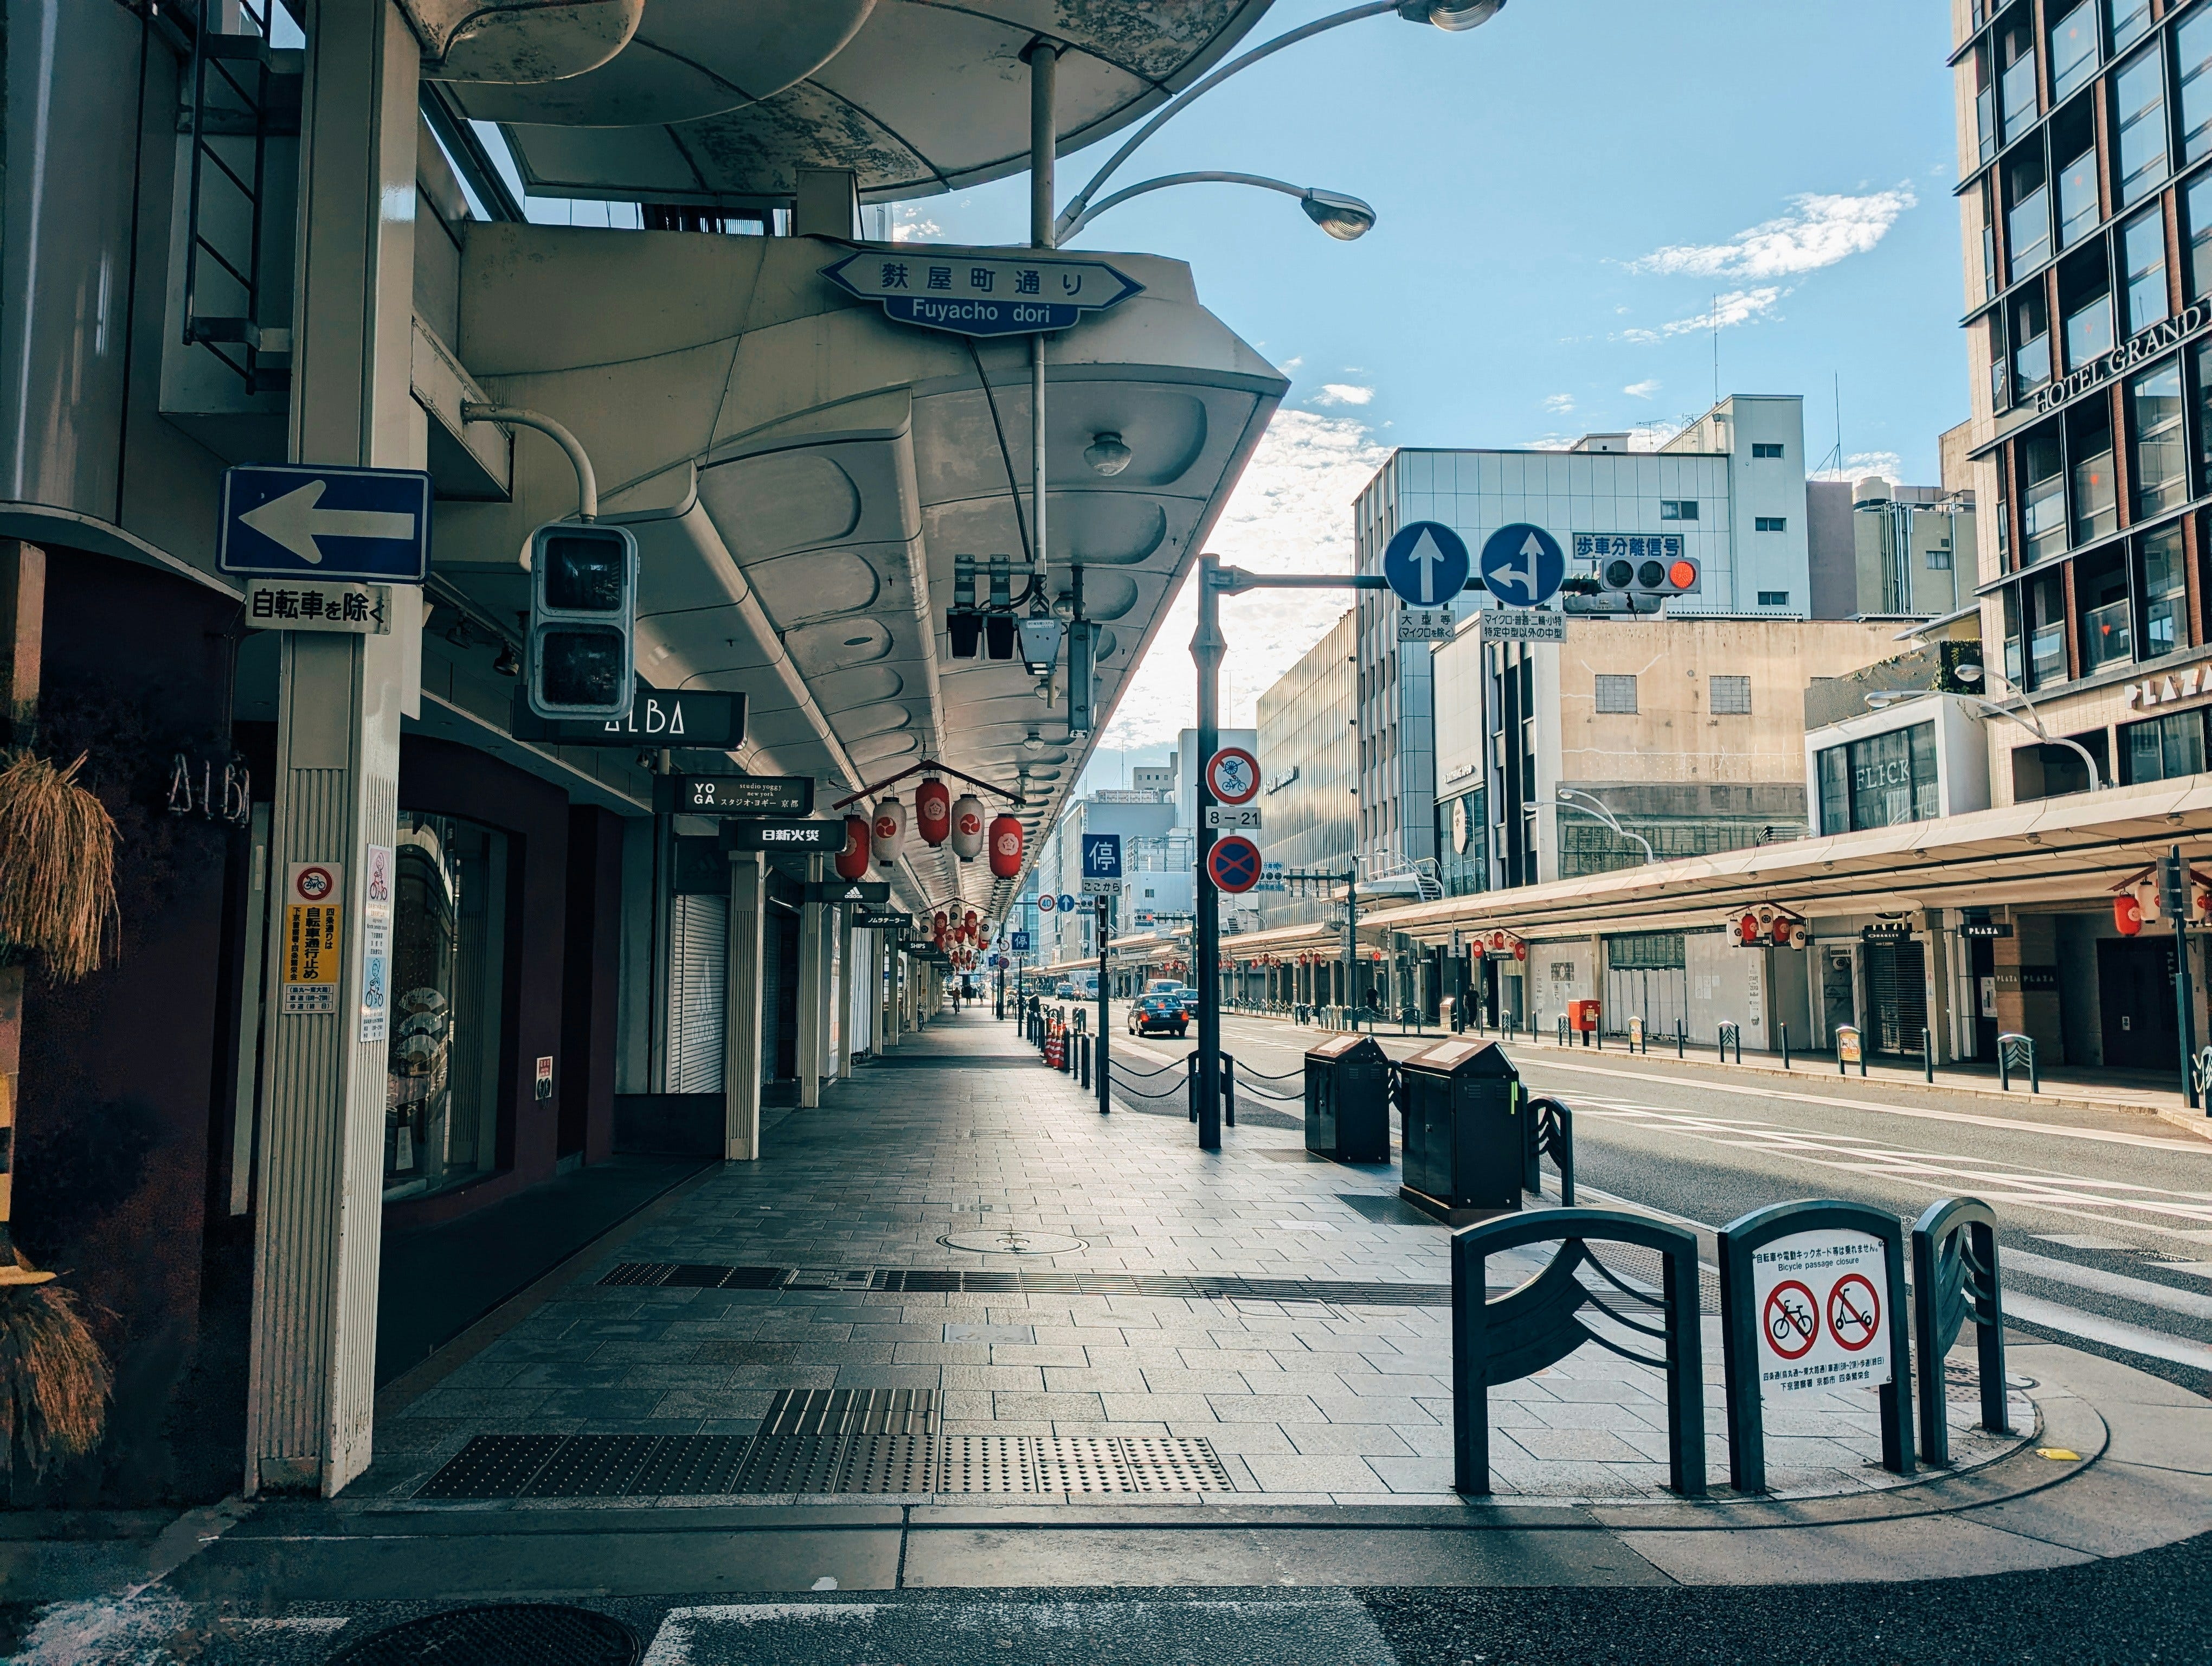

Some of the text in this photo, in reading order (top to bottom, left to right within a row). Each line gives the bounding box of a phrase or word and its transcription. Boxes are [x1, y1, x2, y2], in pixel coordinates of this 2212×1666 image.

[913, 299, 1050, 323] Fuyacho dori
[2034, 361, 2104, 416] HOTEL
[2108, 306, 2201, 373] GRAND
[1577, 536, 1679, 557] 歩車分離信号
[253, 588, 384, 624] 自転車を除く
[1484, 627, 1562, 639] 特定中型以外の中型
[2124, 664, 2212, 709] PLAZA
[1856, 759, 1909, 791] FLICK
[721, 799, 799, 808] スタジオ・ヨギー 京都
[762, 829, 819, 841] 日新火災
[1089, 841, 1115, 870] 停
[1084, 882, 1120, 892] ここから
[1041, 899, 1051, 907] 40
[324, 908, 335, 950] 四条通りは
[303, 907, 321, 979] 自転車通行止め
[1015, 934, 1027, 947] 停
[1778, 1257, 1859, 1272] Bicycle passage closure
[1817, 1376, 1835, 1387] 京都市
